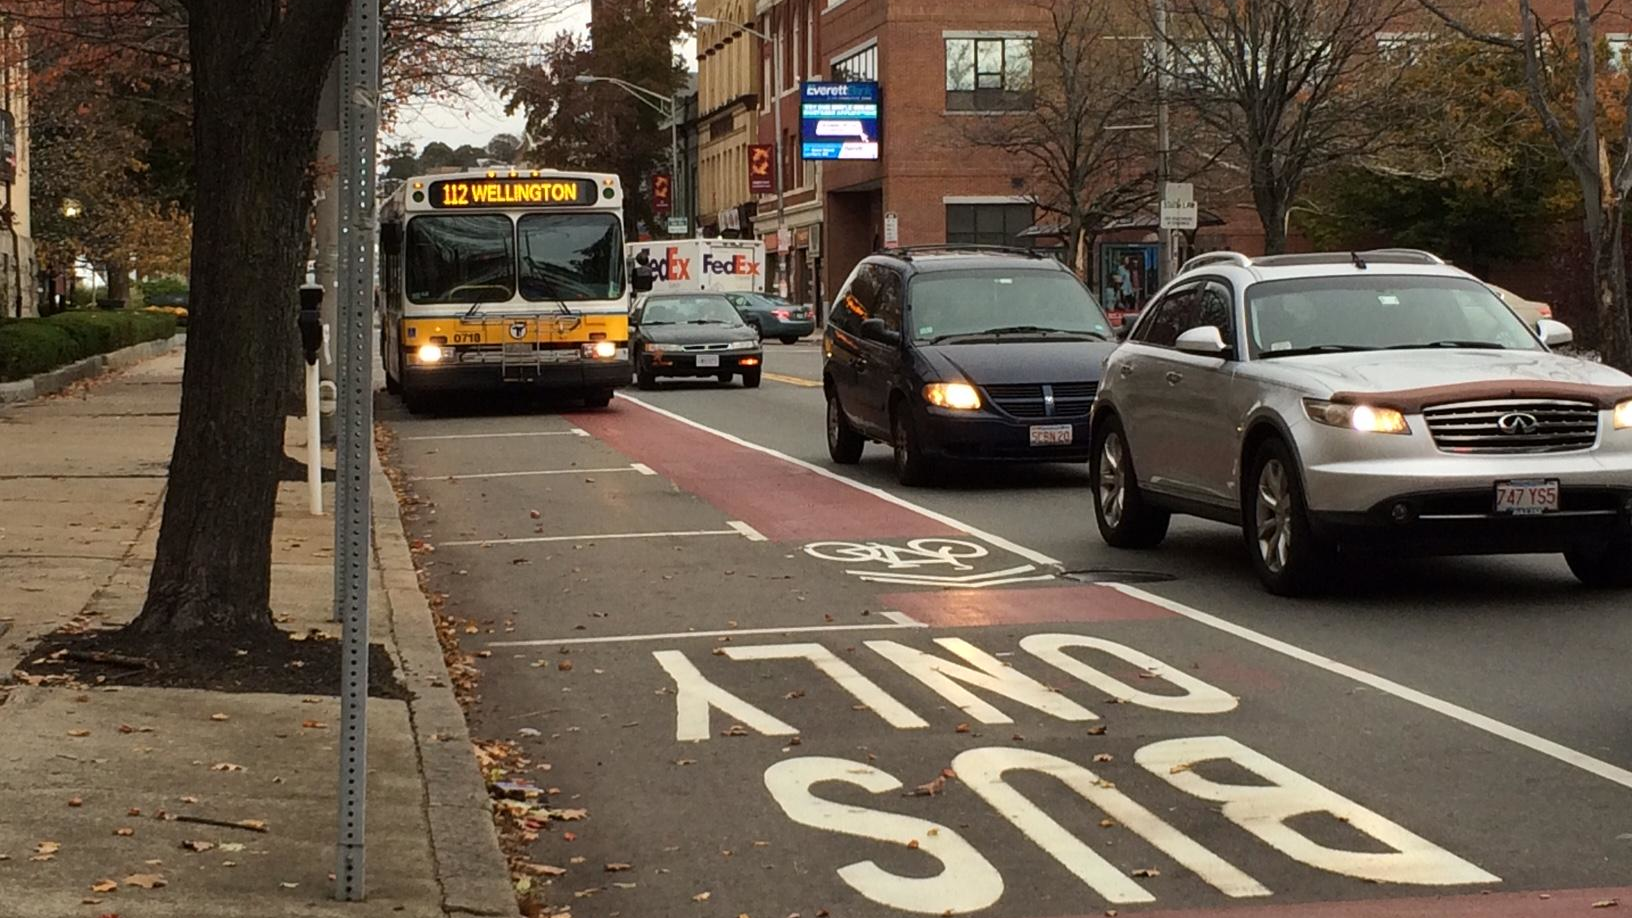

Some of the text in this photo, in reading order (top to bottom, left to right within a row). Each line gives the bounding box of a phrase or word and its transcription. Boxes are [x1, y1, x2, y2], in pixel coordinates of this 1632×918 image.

[442, 183, 577, 205] 112 WELLINGTON
[645, 247, 691, 282] edEx
[703, 254, 760, 276] FedEx
[1496, 487, 1556, 505] 747 YS5
[653, 633, 1239, 741] ONLY
[764, 736, 1503, 914] BUS
